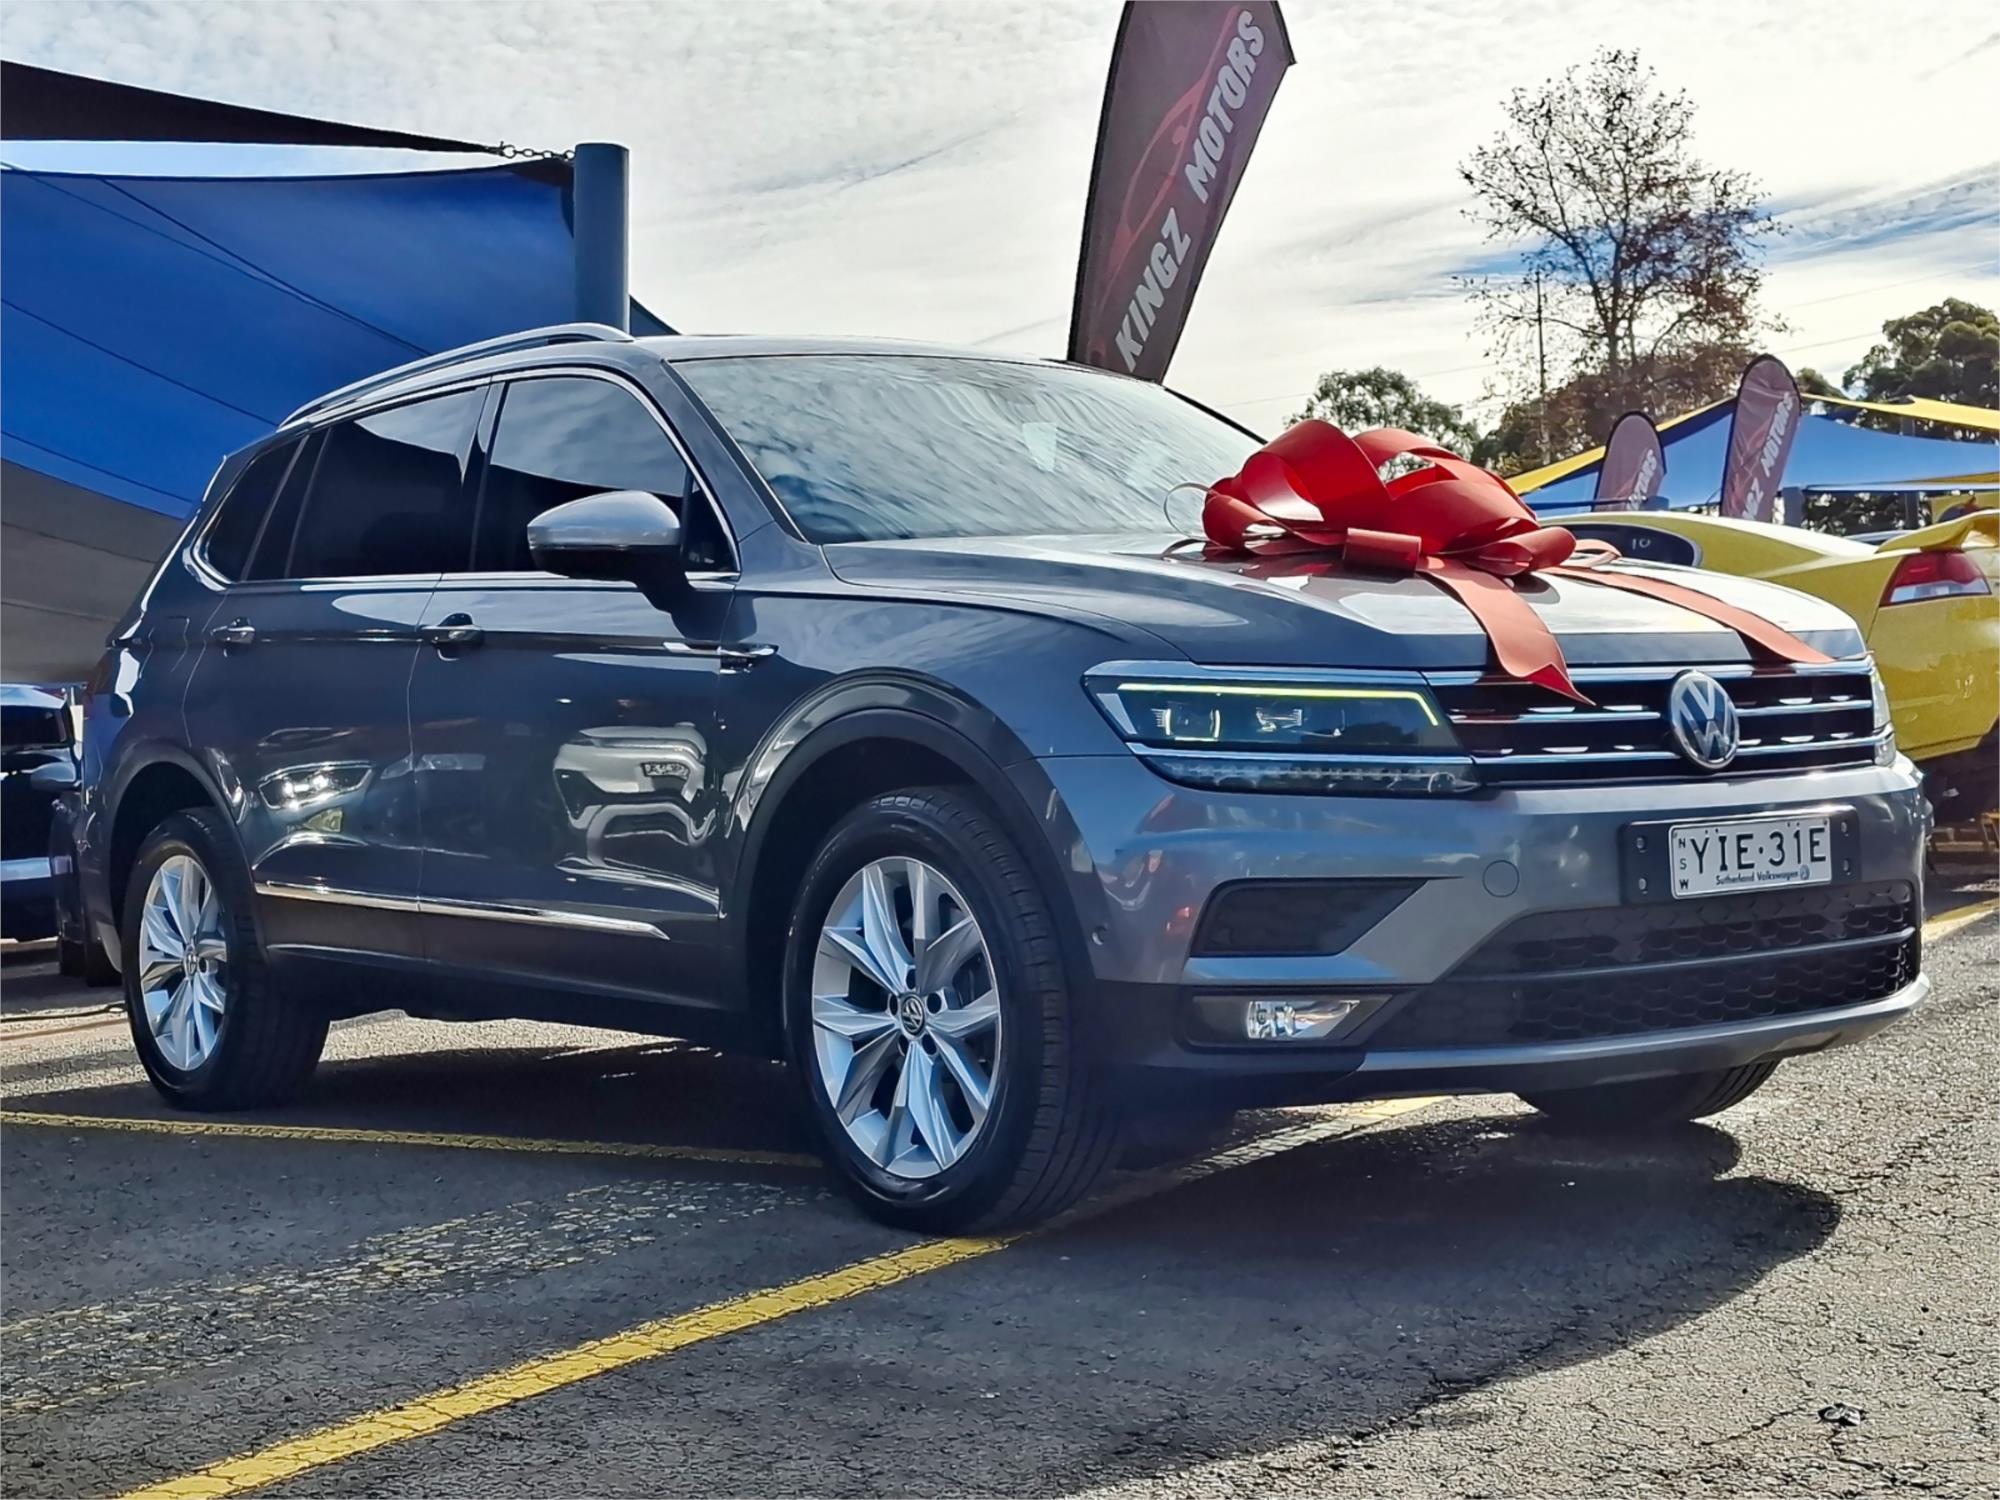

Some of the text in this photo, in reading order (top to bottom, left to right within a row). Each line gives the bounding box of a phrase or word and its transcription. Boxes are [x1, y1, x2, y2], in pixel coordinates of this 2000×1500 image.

[1115, 10, 1265, 373] KINGZ MOTORS
[1715, 870, 1799, 885] Sutherland Volkswagen
